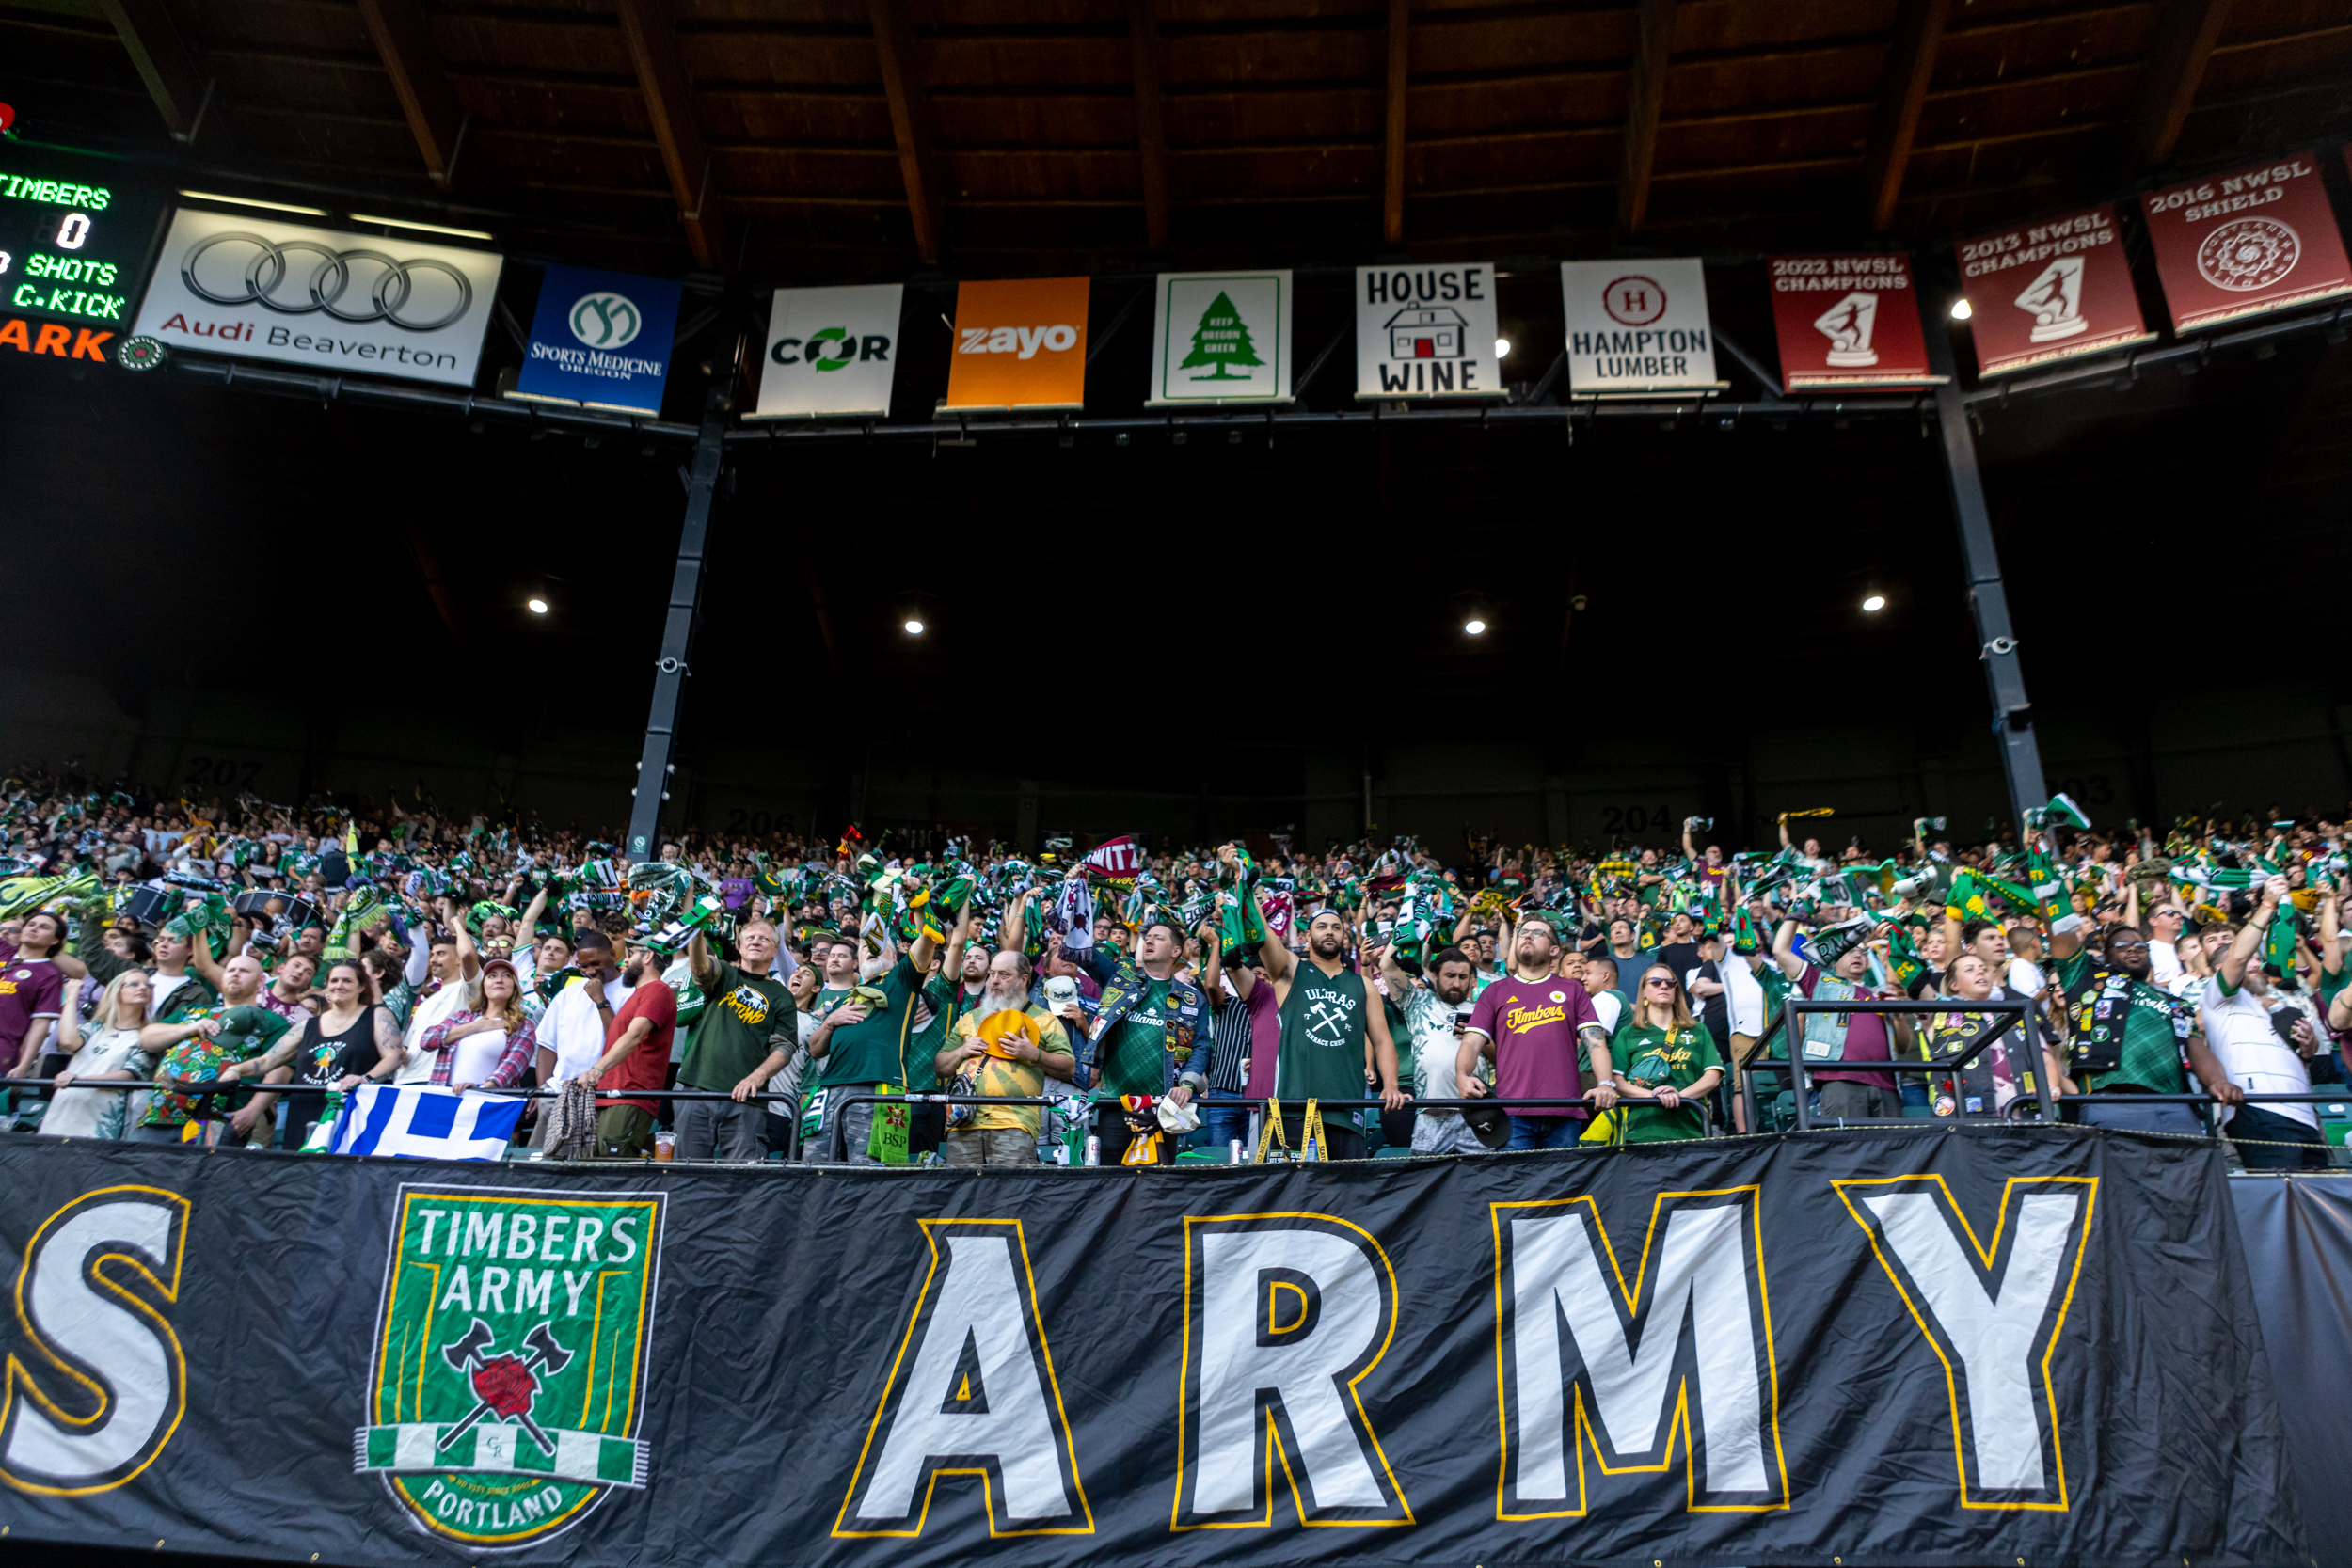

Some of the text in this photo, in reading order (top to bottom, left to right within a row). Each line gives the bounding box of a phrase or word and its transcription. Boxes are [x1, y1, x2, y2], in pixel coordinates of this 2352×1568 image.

[2150, 161, 2312, 214] 2016 NWSL
[2185, 186, 2284, 222] SHIELD
[56, 213, 91, 250] 0
[1962, 212, 2110, 261] 2013 NWSL
[1773, 257, 1905, 276] 2022 NWSL
[1965, 229, 2114, 277] CHAMPIONS
[25, 253, 119, 286] SHOTS
[1775, 275, 1908, 292] CHAMPIONS
[1367, 269, 1484, 304] HOUSE
[1201, 330, 1241, 340] OREGON
[1210, 317, 1234, 326] KEEP
[161, 313, 456, 370] Audi Beaverton
[771, 330, 891, 369] COR
[958, 325, 1077, 359] zayo
[1204, 343, 1237, 353] GREEN
[1572, 330, 1706, 356] HAMPTON
[531, 341, 662, 376] SPORTS MEDICINE
[559, 363, 631, 380] OREGON
[1596, 356, 1687, 378] LUMBER
[1379, 360, 1479, 392] WINE
[185, 757, 263, 792] 207
[726, 809, 795, 837] 206
[1603, 804, 1673, 833] 204
[1304, 988, 1357, 1010] ULTRAS
[1507, 1004, 1566, 1029] Timbers
[1305, 1029, 1329, 1047] TERRACE
[1642, 1047, 1692, 1063] Aska
[882, 1132, 907, 1148] BSP
[418, 1209, 637, 1263] TIMBERS
[438, 1264, 594, 1316] ARMY
[2, 1181, 2090, 1530] S ARMY
[422, 1479, 563, 1528] PORTLAND
[468, 1483, 485, 1495] PITY
[486, 1486, 510, 1496] SINCE
